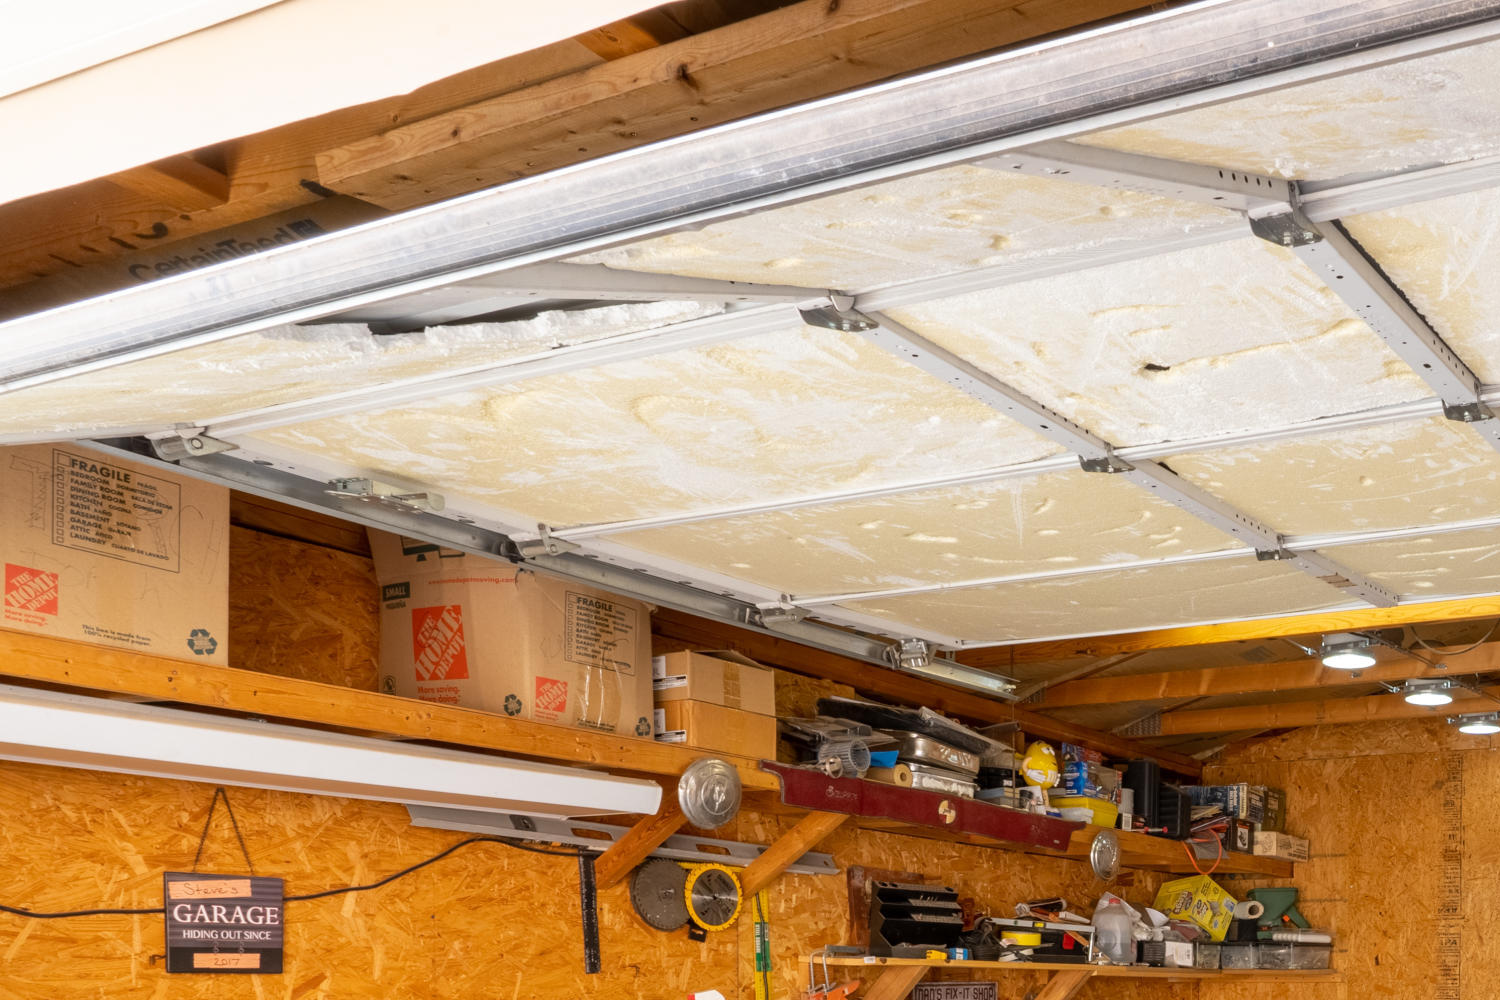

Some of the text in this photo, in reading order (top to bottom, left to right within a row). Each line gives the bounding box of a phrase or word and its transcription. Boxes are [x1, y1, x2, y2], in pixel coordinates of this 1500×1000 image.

[70, 470, 110, 486] BEDROOM
[71, 458, 131, 484] FRAGILE
[70, 478, 124, 497] FAMILY ROOM
[70, 486, 100, 498] DINING
[101, 494, 126, 505] ROOM
[70, 494, 103, 507] KITCHEN
[70, 501, 90, 511] BATH
[70, 509, 110, 523] BASEMENT
[70, 517, 102, 530] GARAGE
[70, 524, 90, 534] ATTIC
[70, 532, 106, 546] LAUNDRY
[10, 570, 33, 587] THE
[6, 573, 58, 609] HOME
[385, 585, 406, 599] SMALL
[26, 589, 57, 611] DEPOT
[576, 596, 614, 612] FRAGILE
[416, 615, 436, 646] THE
[415, 606, 463, 681] HOME
[434, 632, 465, 680] DEPOT
[183, 882, 239, 896] Steve's
[173, 903, 280, 925] GARAGE
[182, 929, 272, 941] HIDING OUT SINCE
[213, 957, 241, 967] 2017
[945, 987, 970, 1000] FIX-IT
